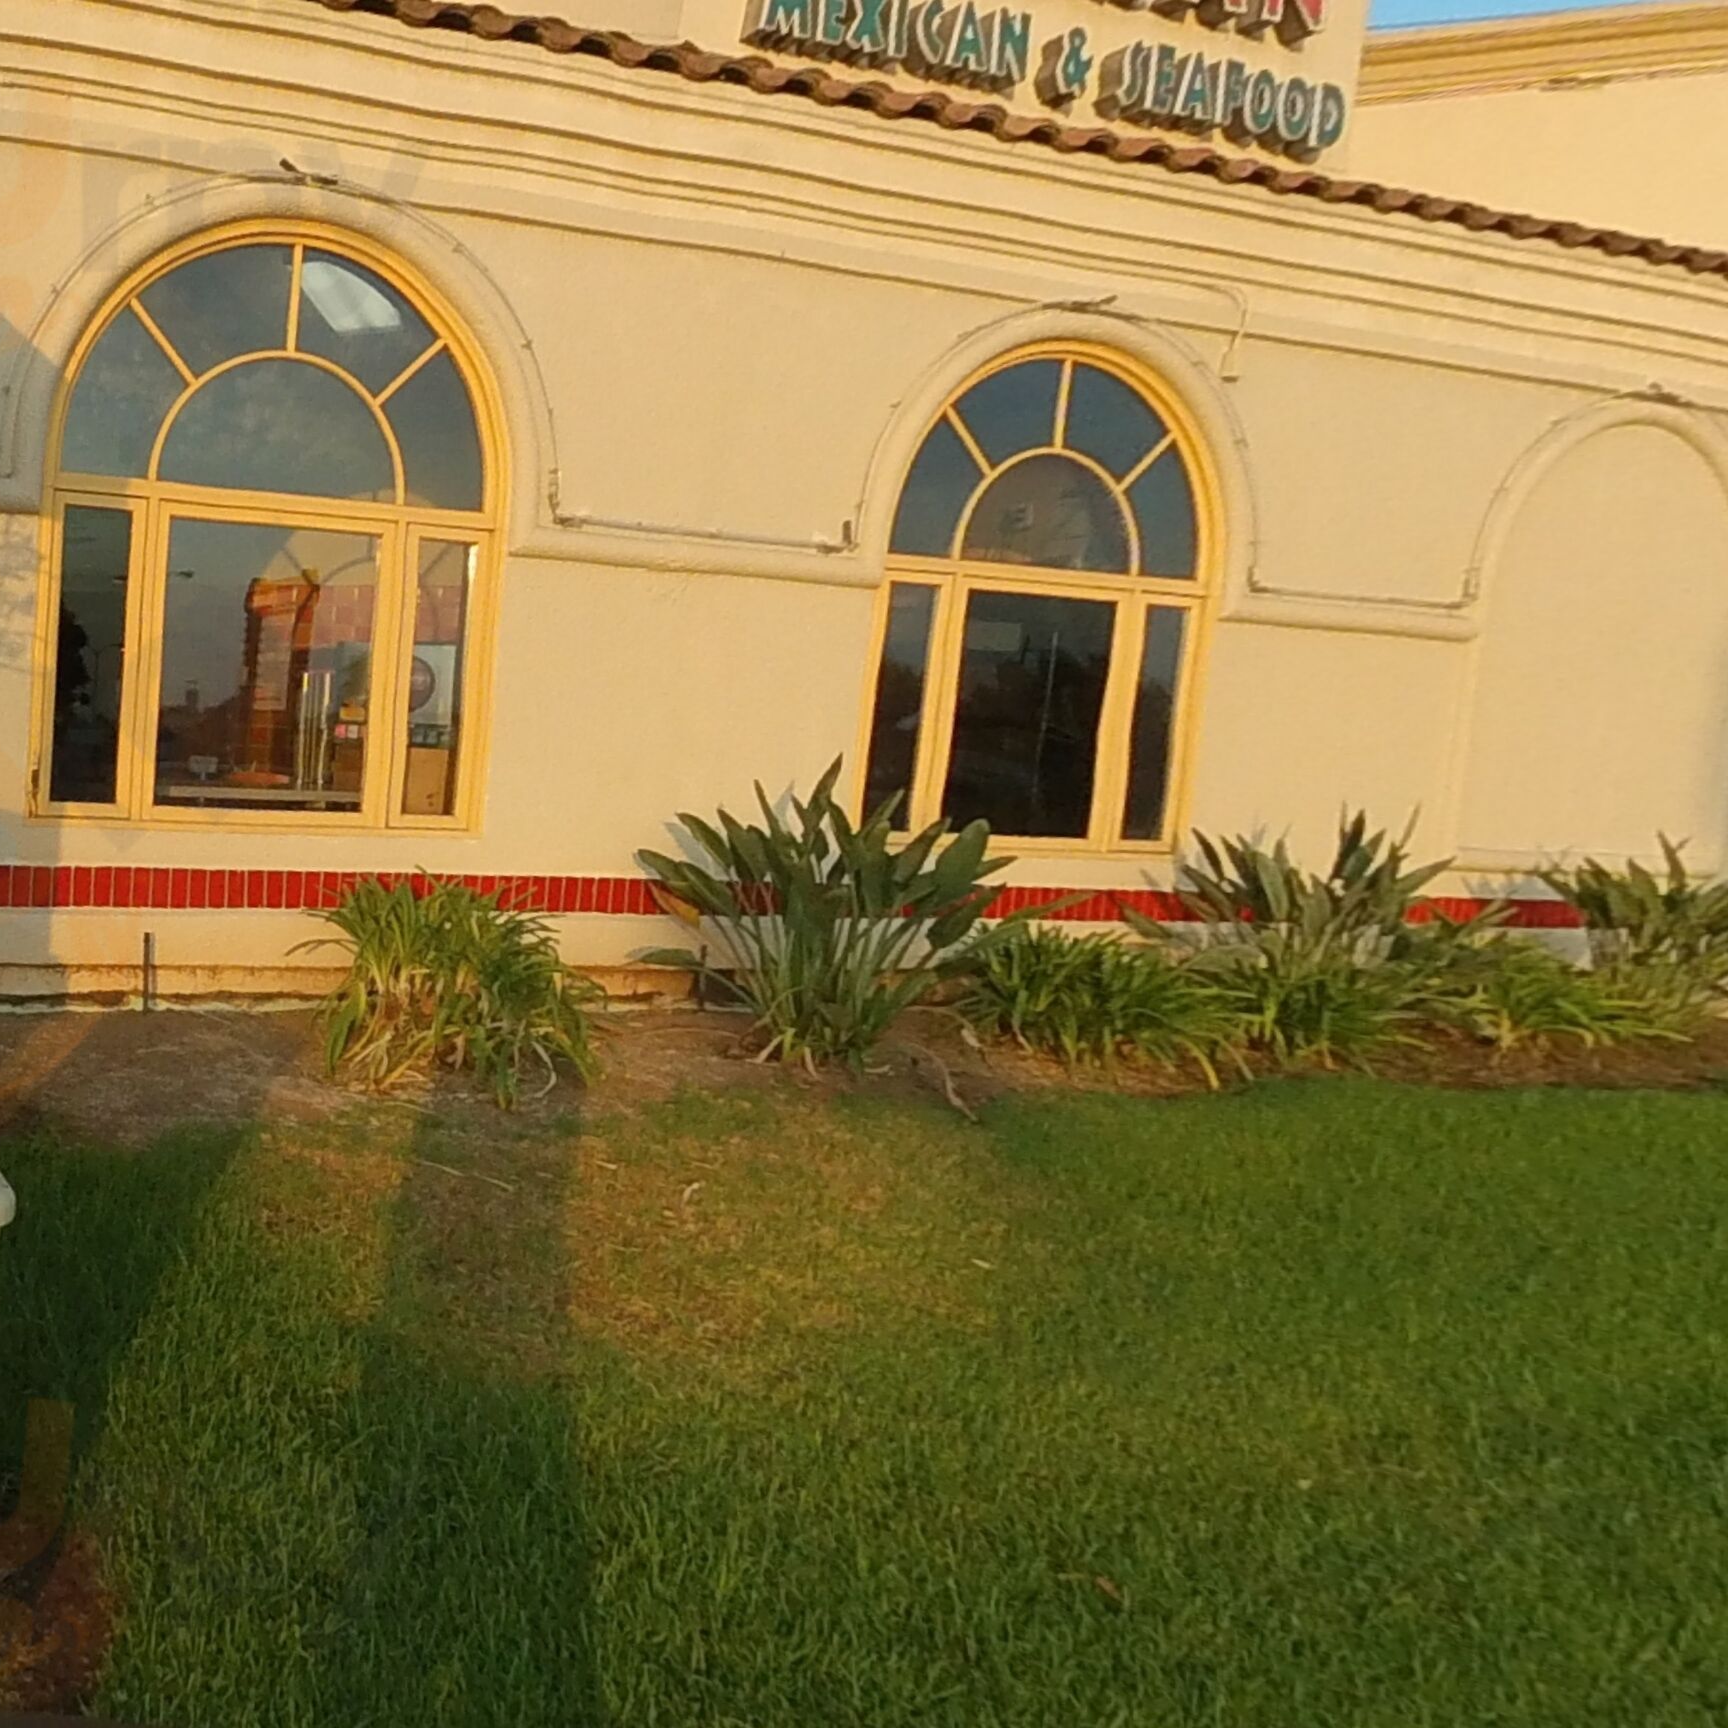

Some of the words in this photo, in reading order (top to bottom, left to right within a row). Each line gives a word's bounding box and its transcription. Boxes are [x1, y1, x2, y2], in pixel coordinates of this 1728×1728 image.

[758, 0, 1031, 83] MEXICAN
[1055, 26, 1094, 98] &
[1117, 40, 1347, 148] SEAFOOD
